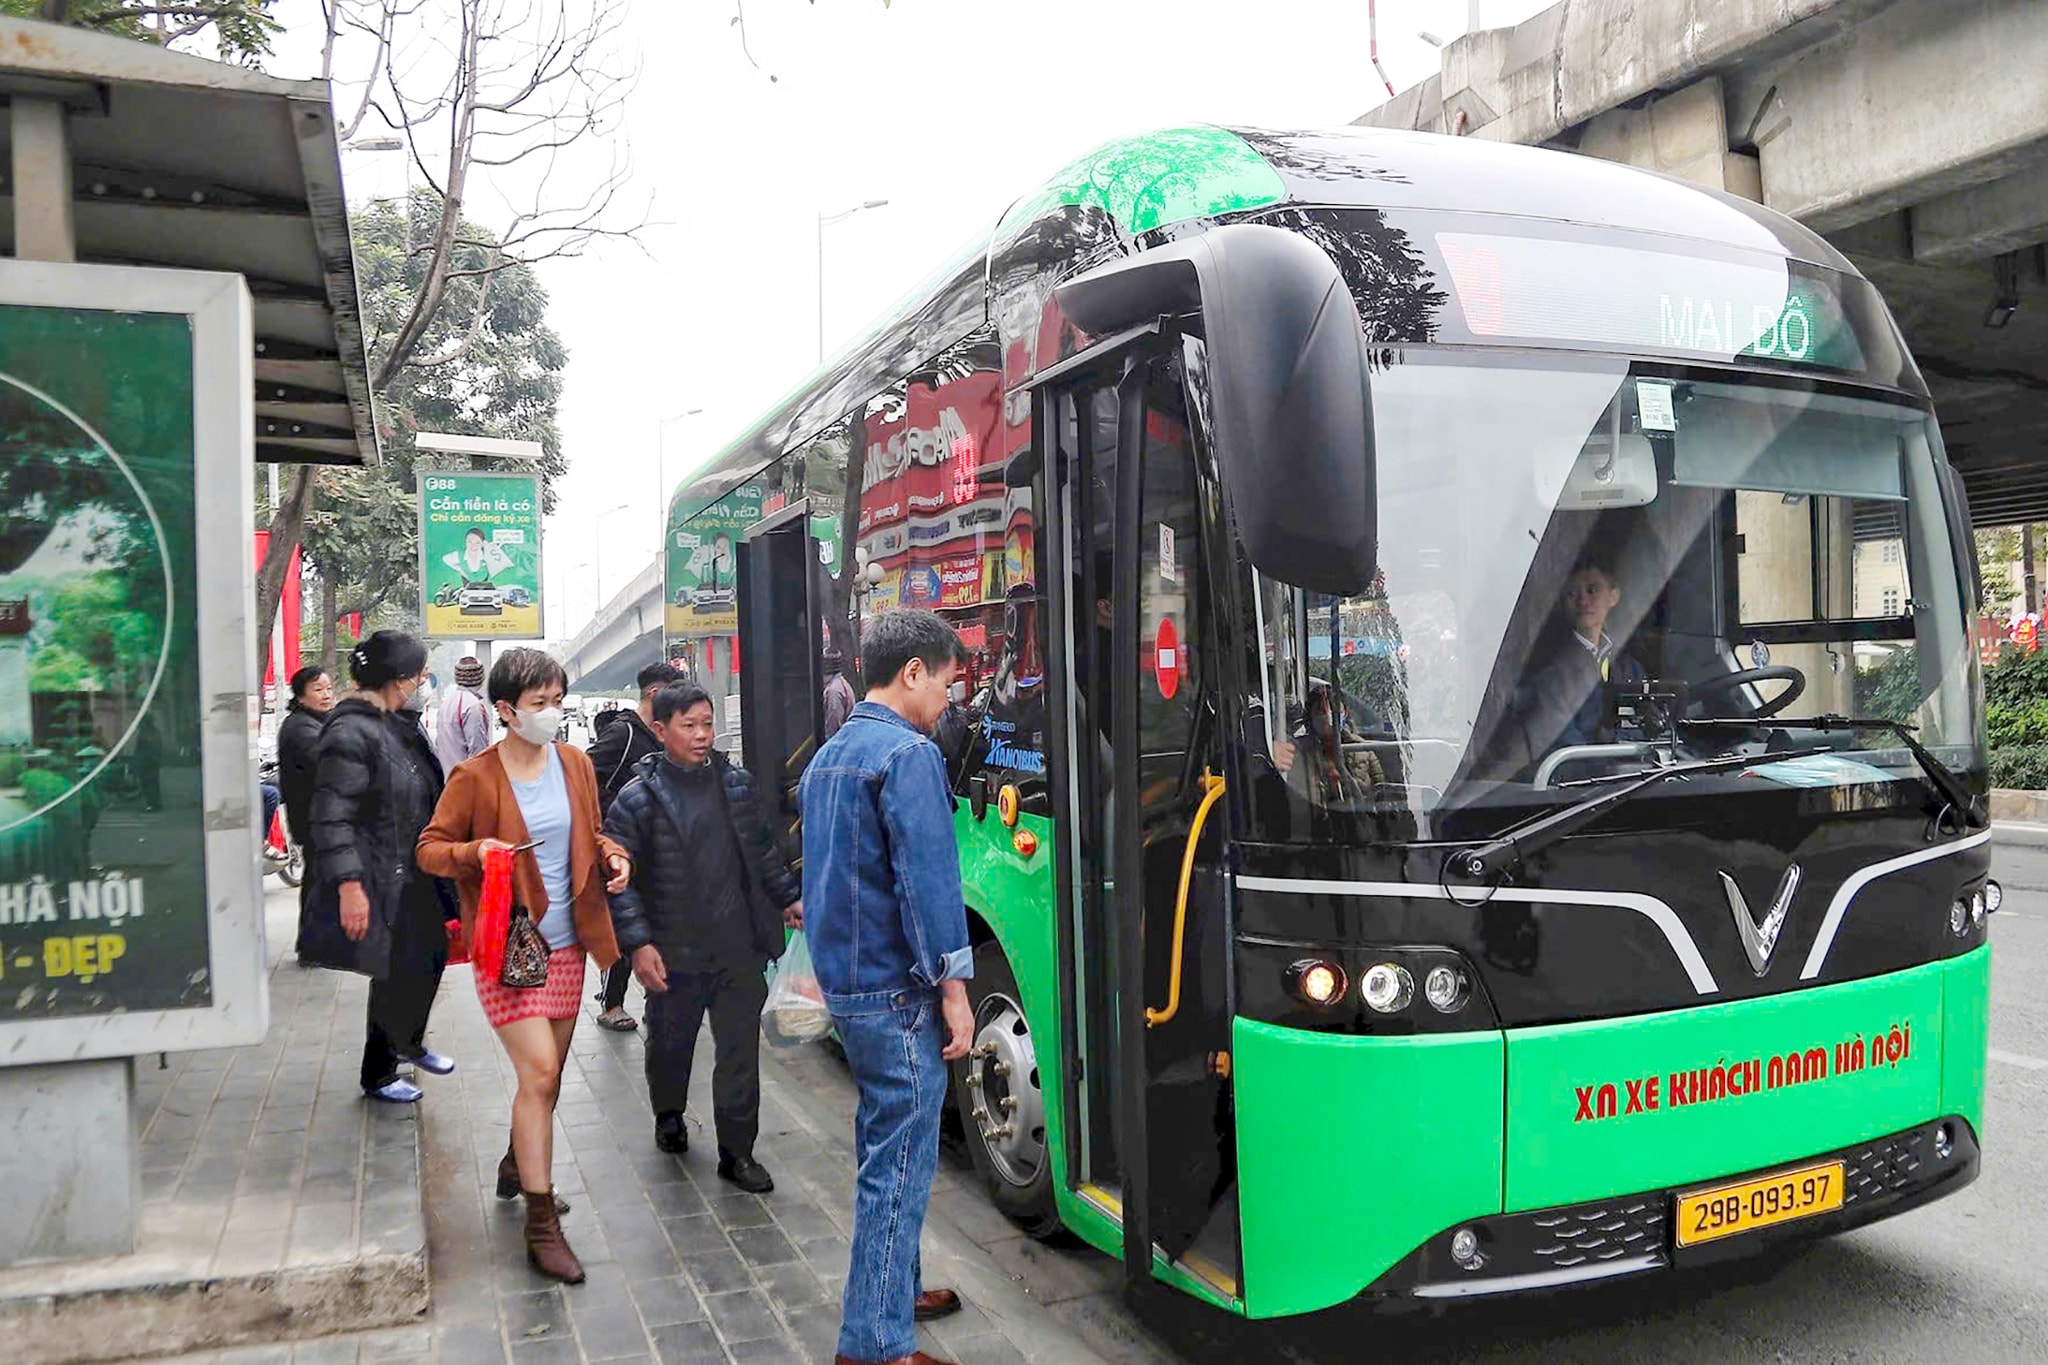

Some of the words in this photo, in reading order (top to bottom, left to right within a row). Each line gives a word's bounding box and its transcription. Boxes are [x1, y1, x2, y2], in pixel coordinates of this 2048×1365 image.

[1659, 293, 1734, 350] MAI
[425, 477, 456, 490] F88
[429, 496, 460, 510] Cần
[464, 496, 491, 510] tiền
[494, 496, 508, 510] là
[512, 498, 530, 511] có
[0, 874, 59, 924] HÀ
[69, 871, 144, 927] NỘI
[43, 934, 127, 984] ĐẸP
[1625, 1075, 1659, 1115] XE
[1669, 1057, 1760, 1108] KHÁCH
[1835, 1032, 1865, 1076] HÀ
[1693, 1174, 1831, 1233] 29B-093.97
